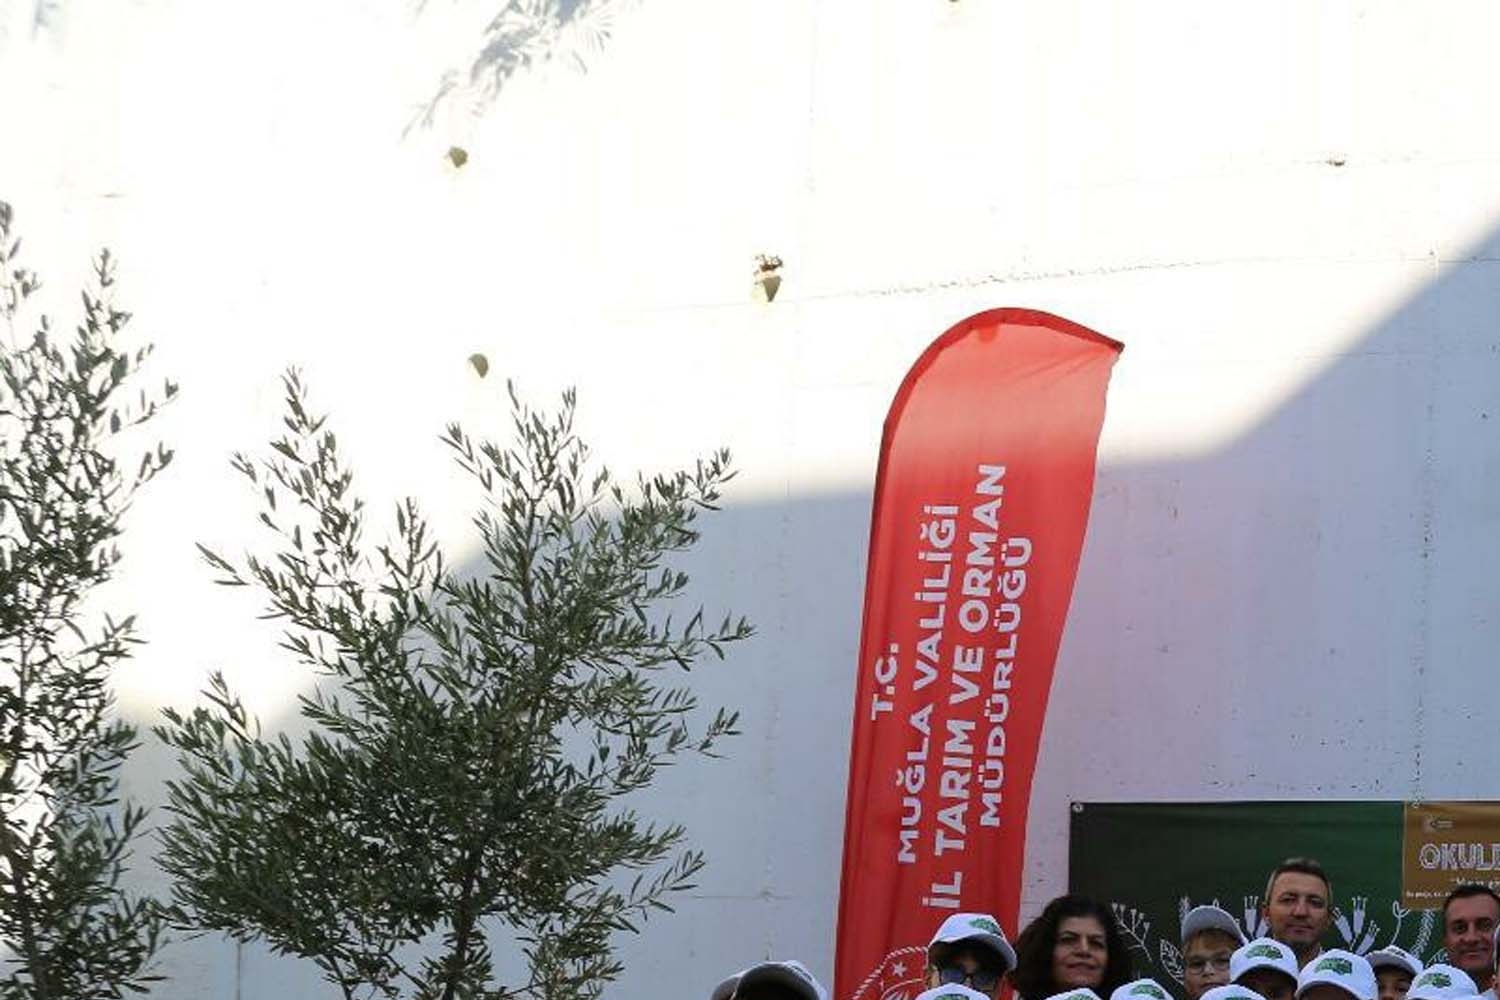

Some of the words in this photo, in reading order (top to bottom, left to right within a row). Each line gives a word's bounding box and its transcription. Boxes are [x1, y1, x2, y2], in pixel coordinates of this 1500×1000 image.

[913, 505, 959, 691] VALİLİĞİ
[958, 464, 1007, 633] ORMAN
[871, 643, 899, 721] T.C.
[949, 645, 984, 704] VE
[977, 537, 1032, 826] MÜDÜRLÜĞÜ
[896, 704, 933, 863] MUĞLA
[934, 719, 976, 856] TARIM
[922, 871, 962, 908] İL
